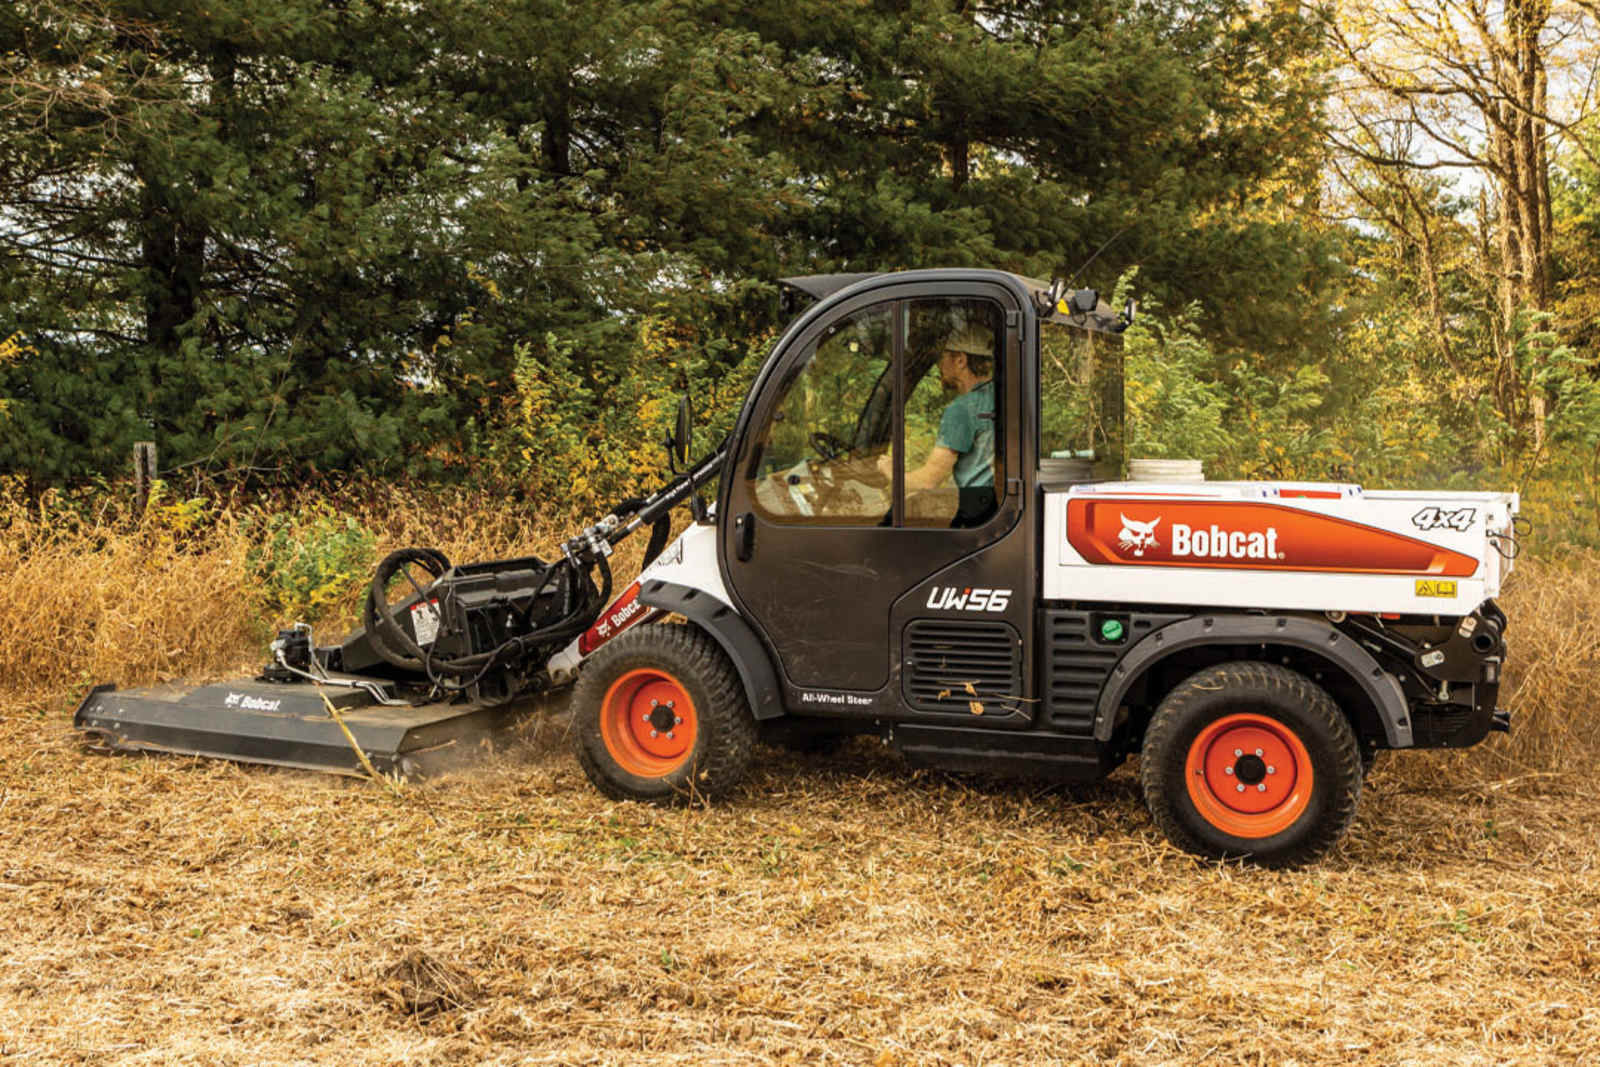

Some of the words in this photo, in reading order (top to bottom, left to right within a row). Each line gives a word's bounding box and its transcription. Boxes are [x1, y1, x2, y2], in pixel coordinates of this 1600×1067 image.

[1411, 506, 1476, 532] 4x4
[1171, 523, 1278, 560] Bobcat
[802, 692, 845, 704] All-Wheel
[847, 695, 873, 705] Steer
